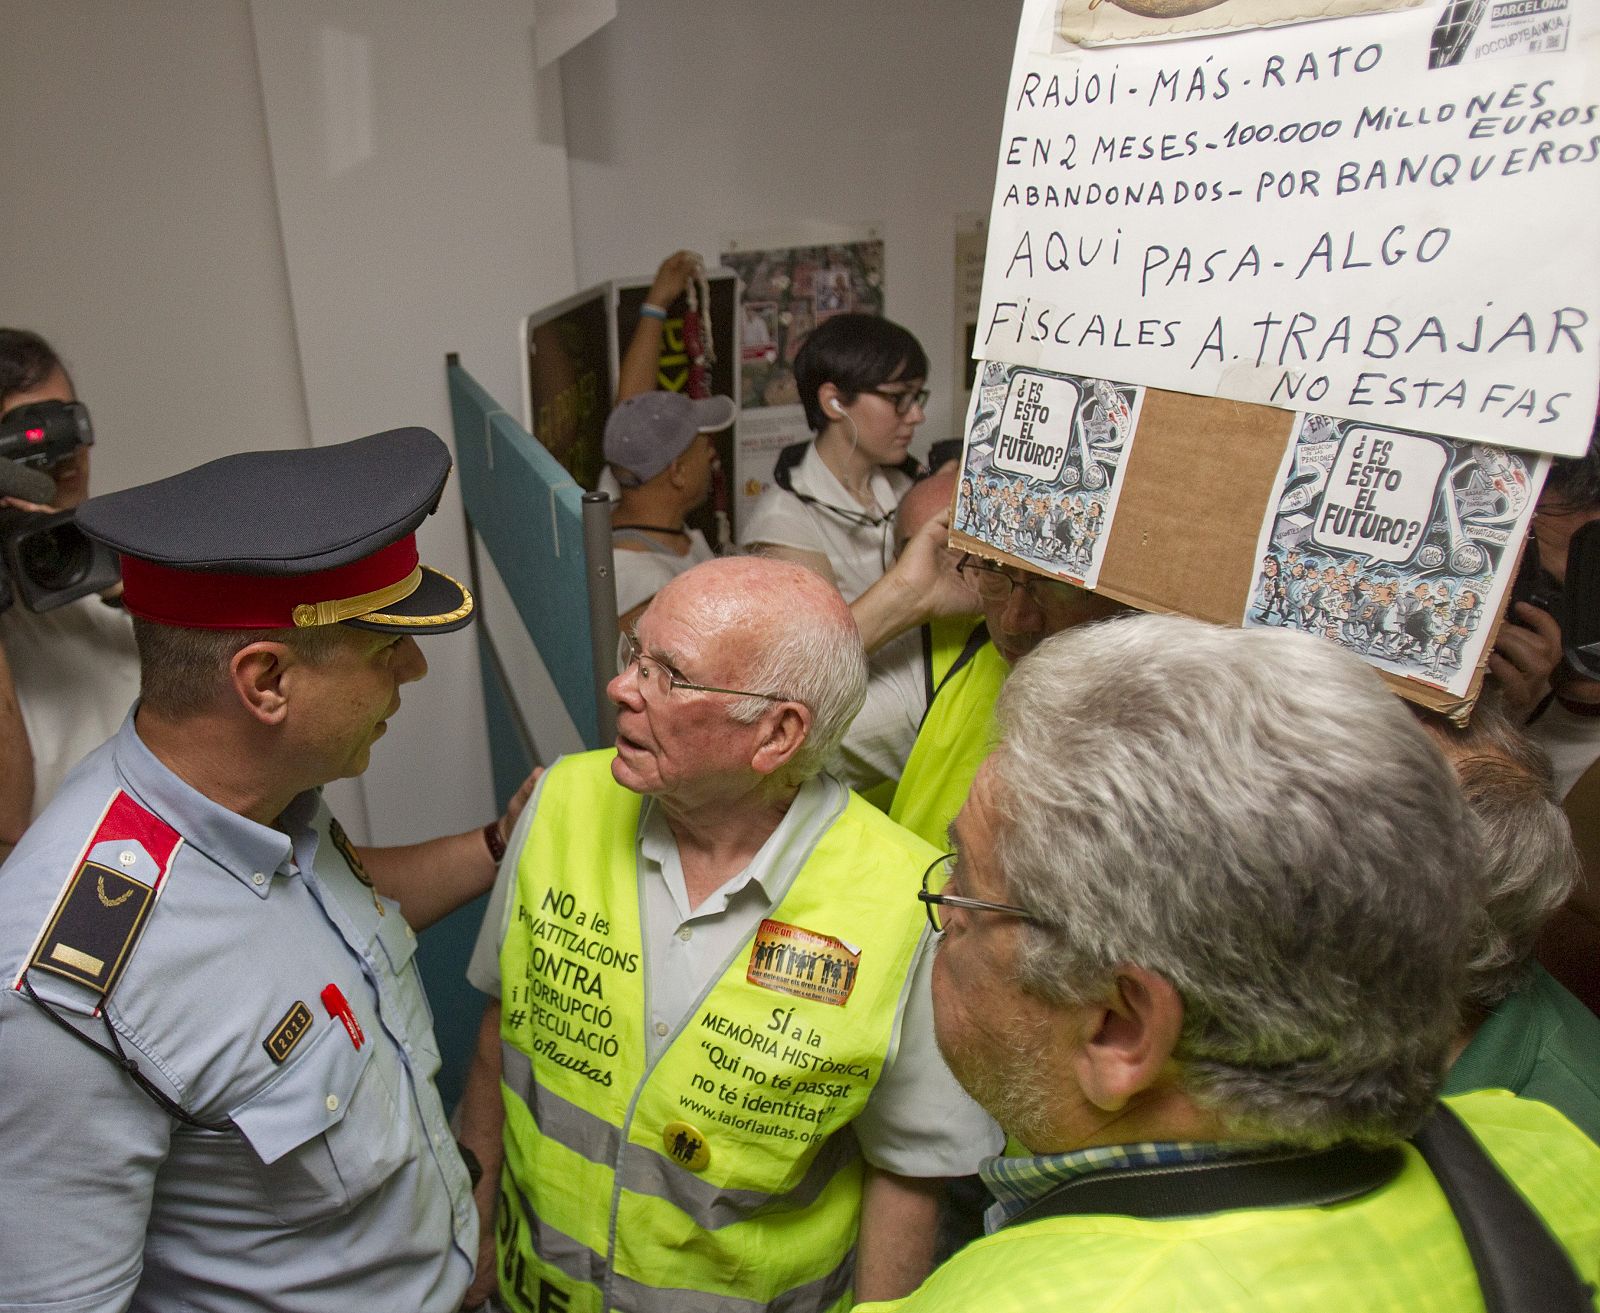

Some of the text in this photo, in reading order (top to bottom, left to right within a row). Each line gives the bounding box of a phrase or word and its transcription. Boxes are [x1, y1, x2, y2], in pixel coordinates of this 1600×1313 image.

[1493, 0, 1567, 17] BARCELONA
[1468, 104, 1599, 139] EUROS
[1006, 136, 1050, 168] EN
[1059, 133, 1077, 170] 2
[1256, 169, 1321, 203] POR
[1336, 136, 1600, 196] BANQUEROS
[1269, 370, 1330, 403] NO
[1013, 401, 1050, 424] ESTO
[1307, 415, 1331, 434] ERE
[1019, 422, 1034, 441] EL
[997, 434, 1064, 470] FUTURO?
[1345, 461, 1403, 492] ESTO
[1354, 487, 1378, 512] EL
[1319, 502, 1422, 549] FUTURO?
[541, 887, 610, 936] NO a les
[532, 944, 604, 1000] ONTRA
[532, 978, 612, 1029] ORRUPCIÓ
[278, 1013, 306, 1050] 2013
[767, 1007, 821, 1048] SÍ a la
[701, 1012, 870, 1080] MEMÒRIA HISTÒRICA
[691, 1073, 715, 1094] no
[719, 1083, 738, 1105] té
[742, 1065, 766, 1086] no
[771, 1074, 792, 1091] té
[794, 1080, 852, 1099] passat
